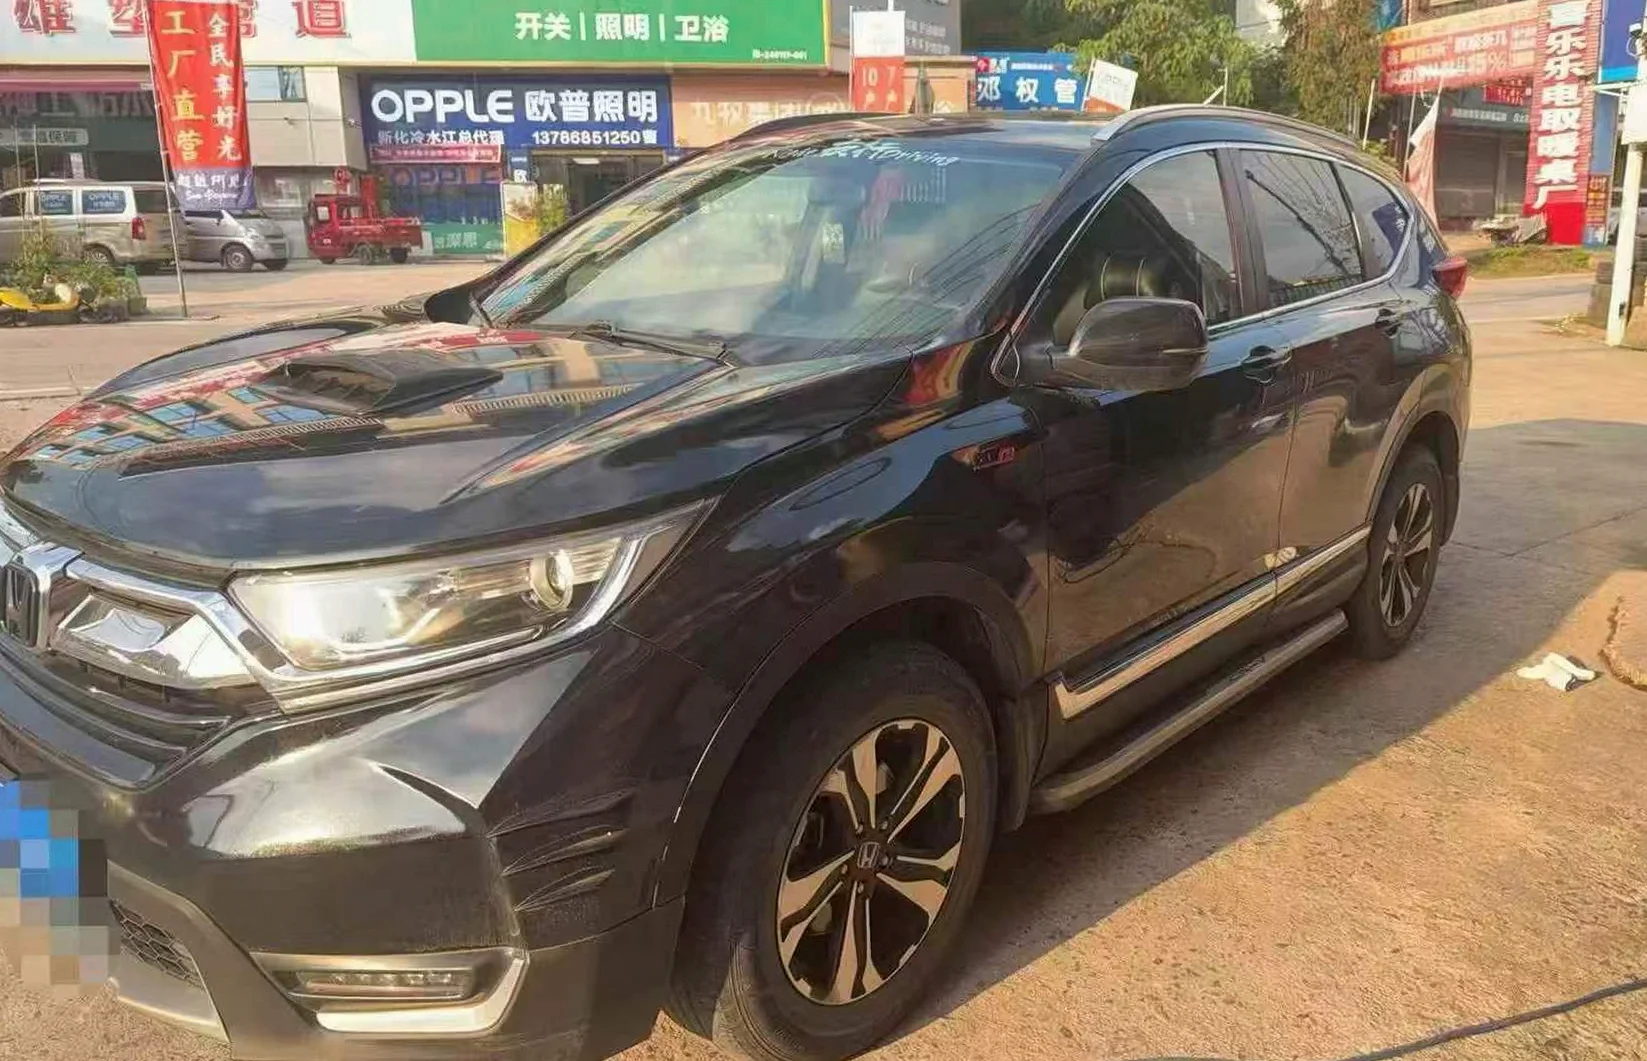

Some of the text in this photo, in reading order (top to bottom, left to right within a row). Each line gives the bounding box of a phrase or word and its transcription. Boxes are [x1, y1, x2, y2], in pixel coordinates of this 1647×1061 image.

[514, 12, 729, 42] 开关 照明 卫浴
[161, 10, 206, 162] 工厂直营
[371, 89, 515, 123] OPPLE
[524, 90, 658, 122] 欧普照明
[377, 130, 504, 145] 新化冷水江总代理
